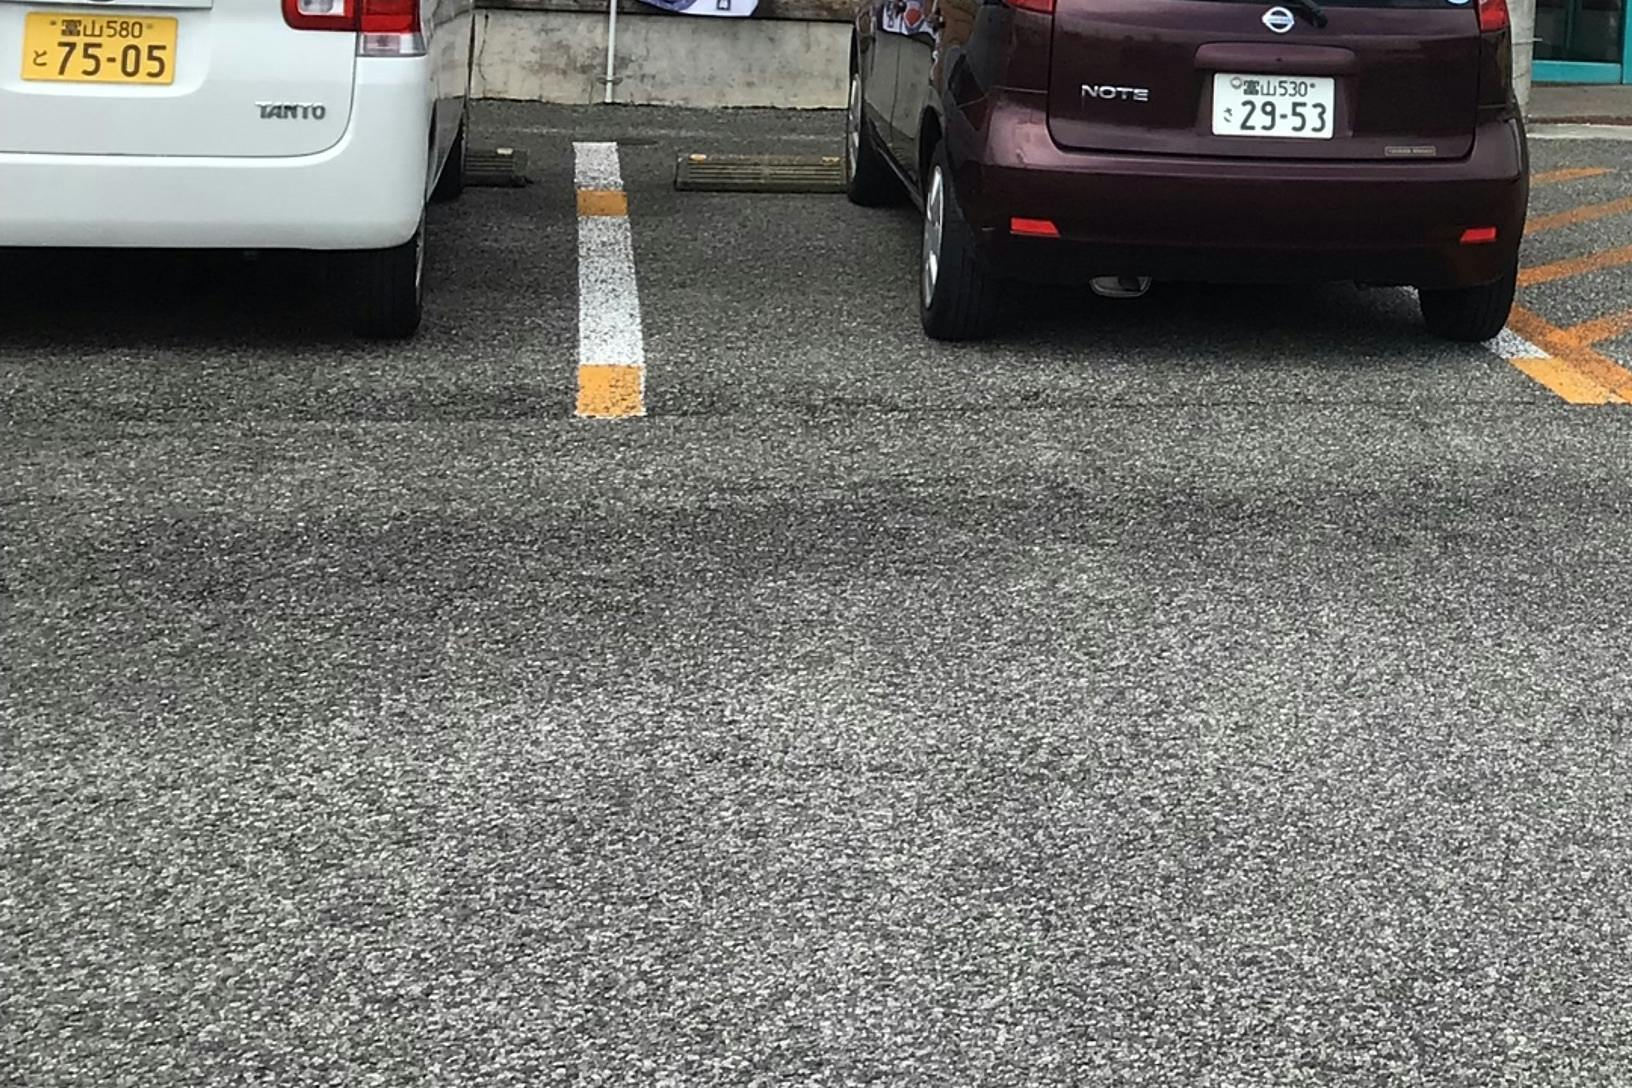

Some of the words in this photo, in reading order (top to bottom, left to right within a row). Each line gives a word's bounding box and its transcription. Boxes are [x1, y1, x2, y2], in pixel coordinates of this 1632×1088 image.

[57, 41, 167, 79] 75-05
[1080, 84, 1150, 102] NOTE
[255, 100, 326, 120] TANTO
[1240, 100, 1327, 133] 29-53
